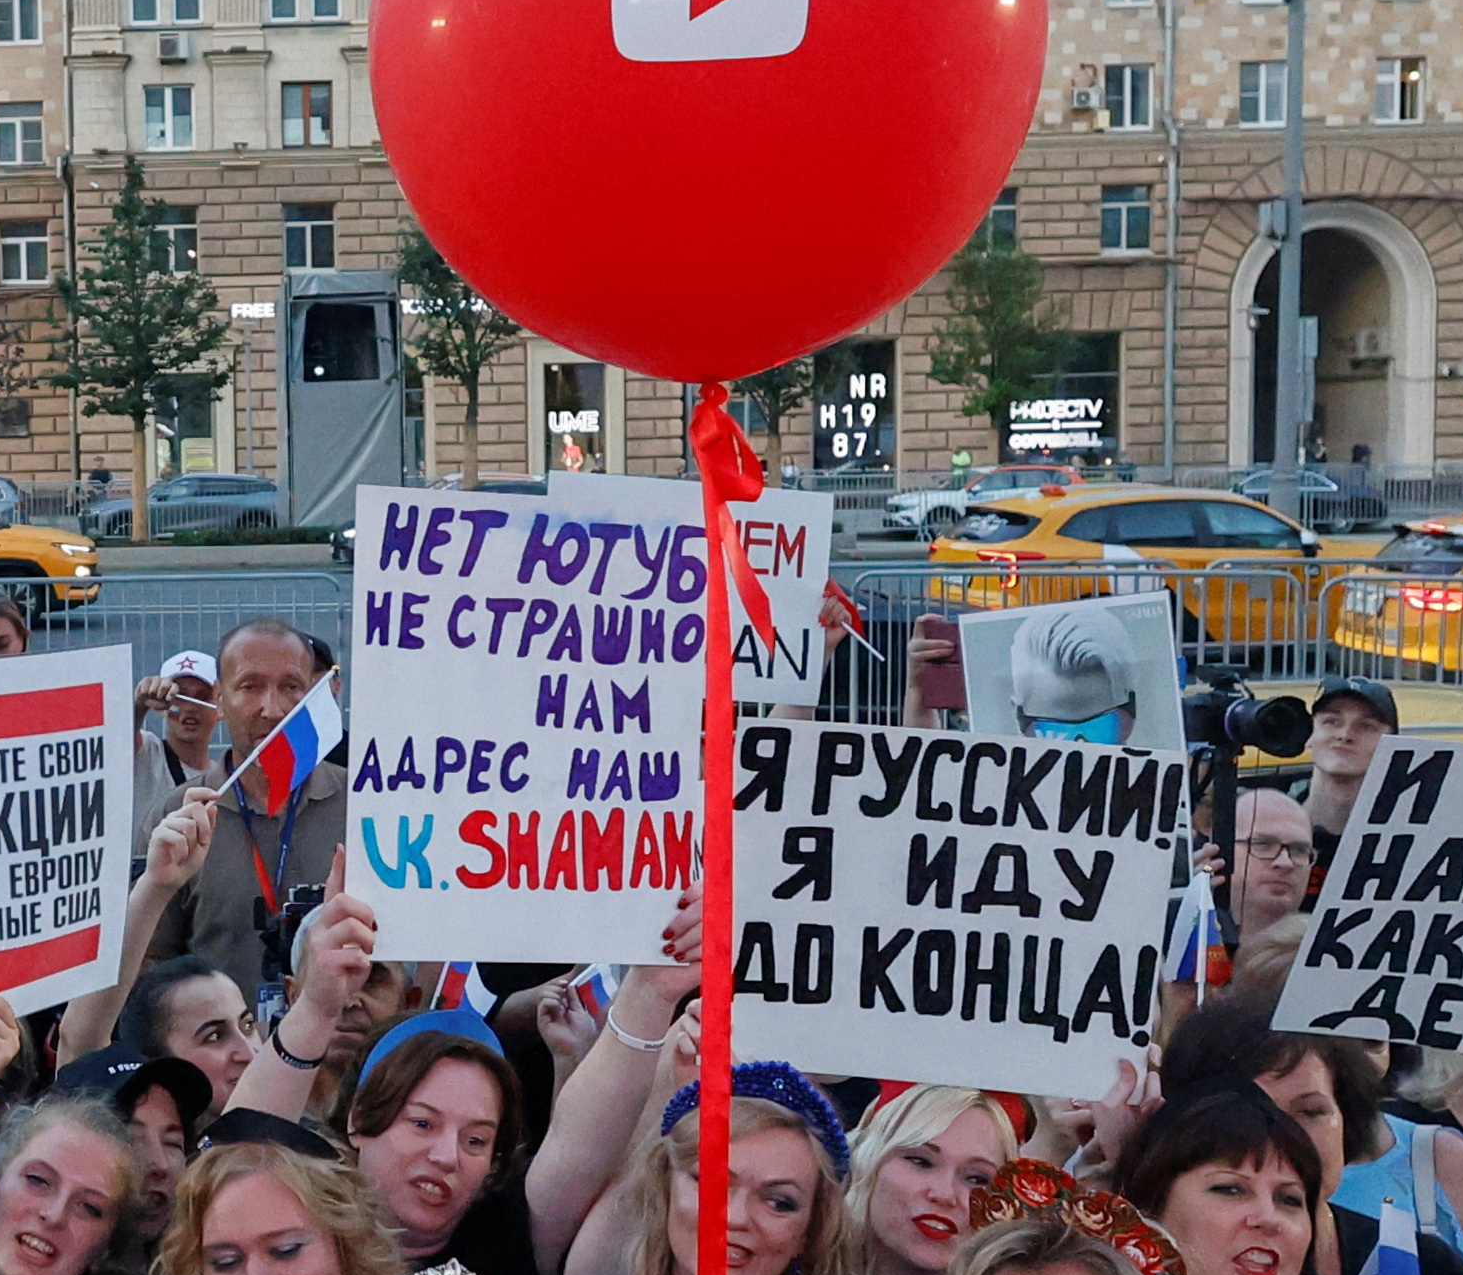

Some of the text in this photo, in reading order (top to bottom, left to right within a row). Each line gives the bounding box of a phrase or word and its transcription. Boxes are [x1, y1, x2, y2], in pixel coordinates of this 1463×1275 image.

[231, 303, 275, 318] FREE
[379, 502, 706, 604] НЕТ ЮТУБ
[365, 590, 705, 665] НЕ СТРАШНО
[535, 673, 651, 734] НАМ
[39, 735, 105, 778] СВОИ
[352, 735, 681, 802] АДРЕС НАШ
[732, 727, 1184, 849] Я РУССКИЙ!
[1368, 749, 1453, 825] И
[9, 847, 104, 899] ЕВРОПУ
[53, 887, 102, 929] США
[772, 827, 833, 901] Я
[907, 833, 1114, 922] ИДУ
[732, 922, 1158, 1047] ДО КОНЦА!
